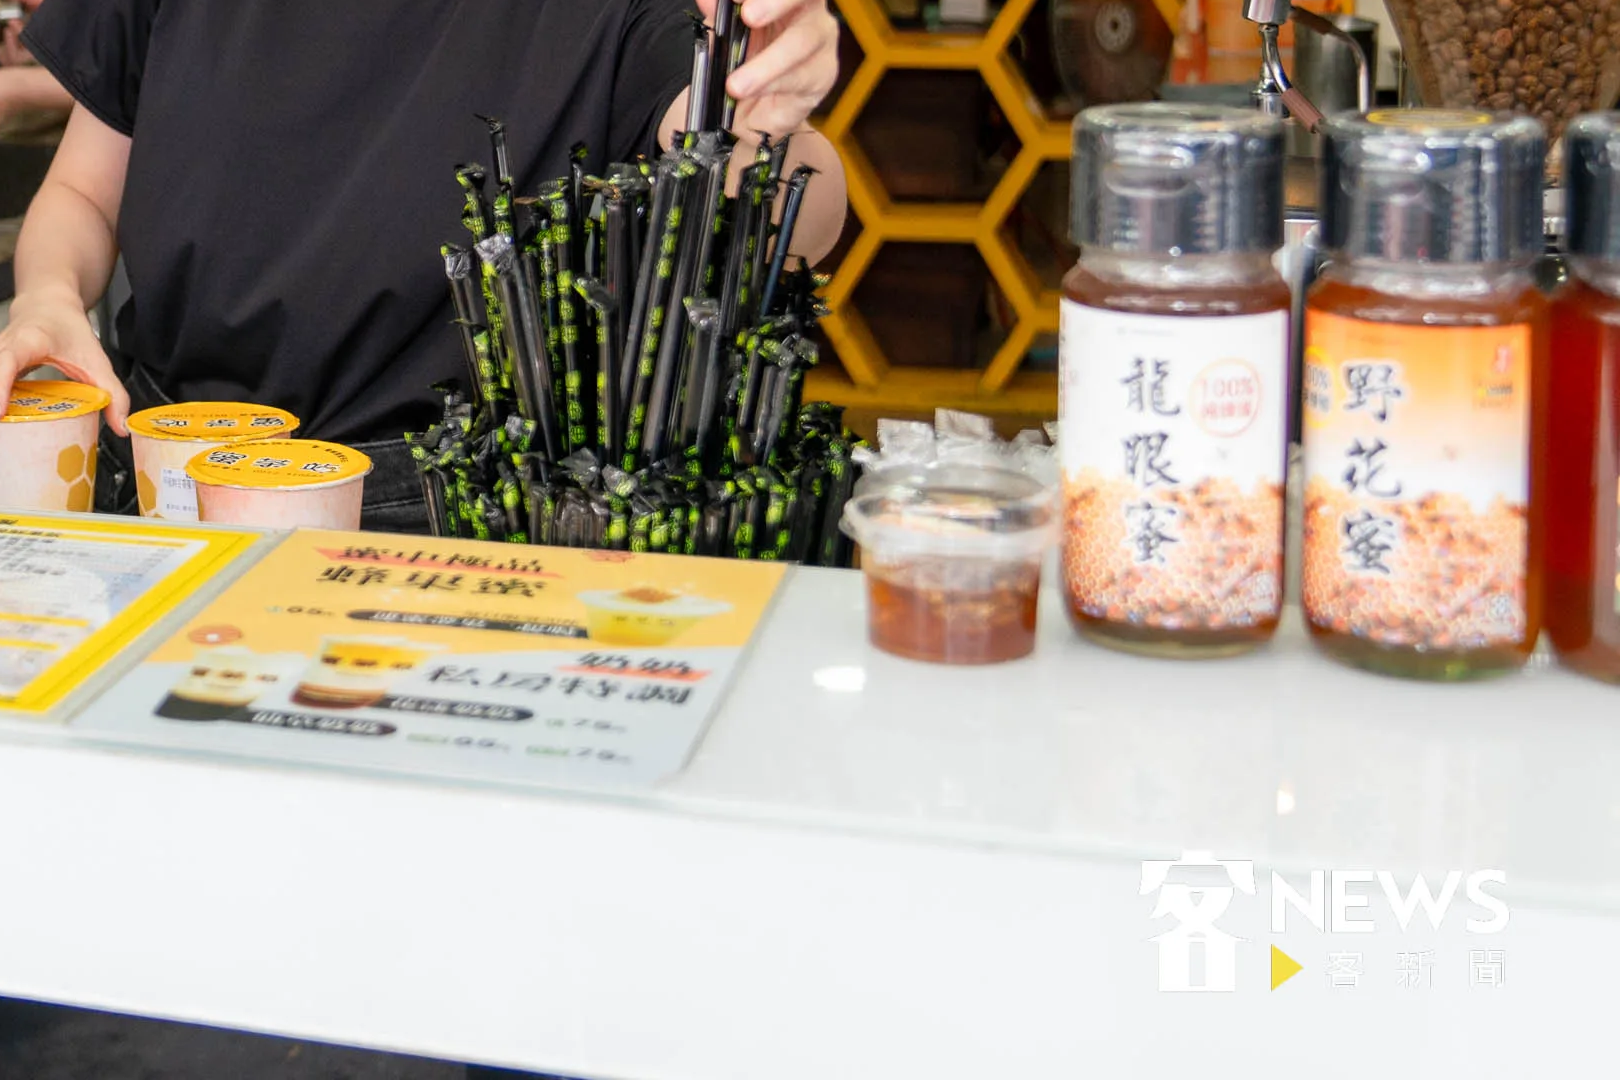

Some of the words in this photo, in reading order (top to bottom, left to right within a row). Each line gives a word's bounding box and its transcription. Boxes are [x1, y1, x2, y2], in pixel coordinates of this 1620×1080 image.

[1119, 355, 1182, 566] 龍眼蜜
[1341, 361, 1403, 577] 野花蜜
